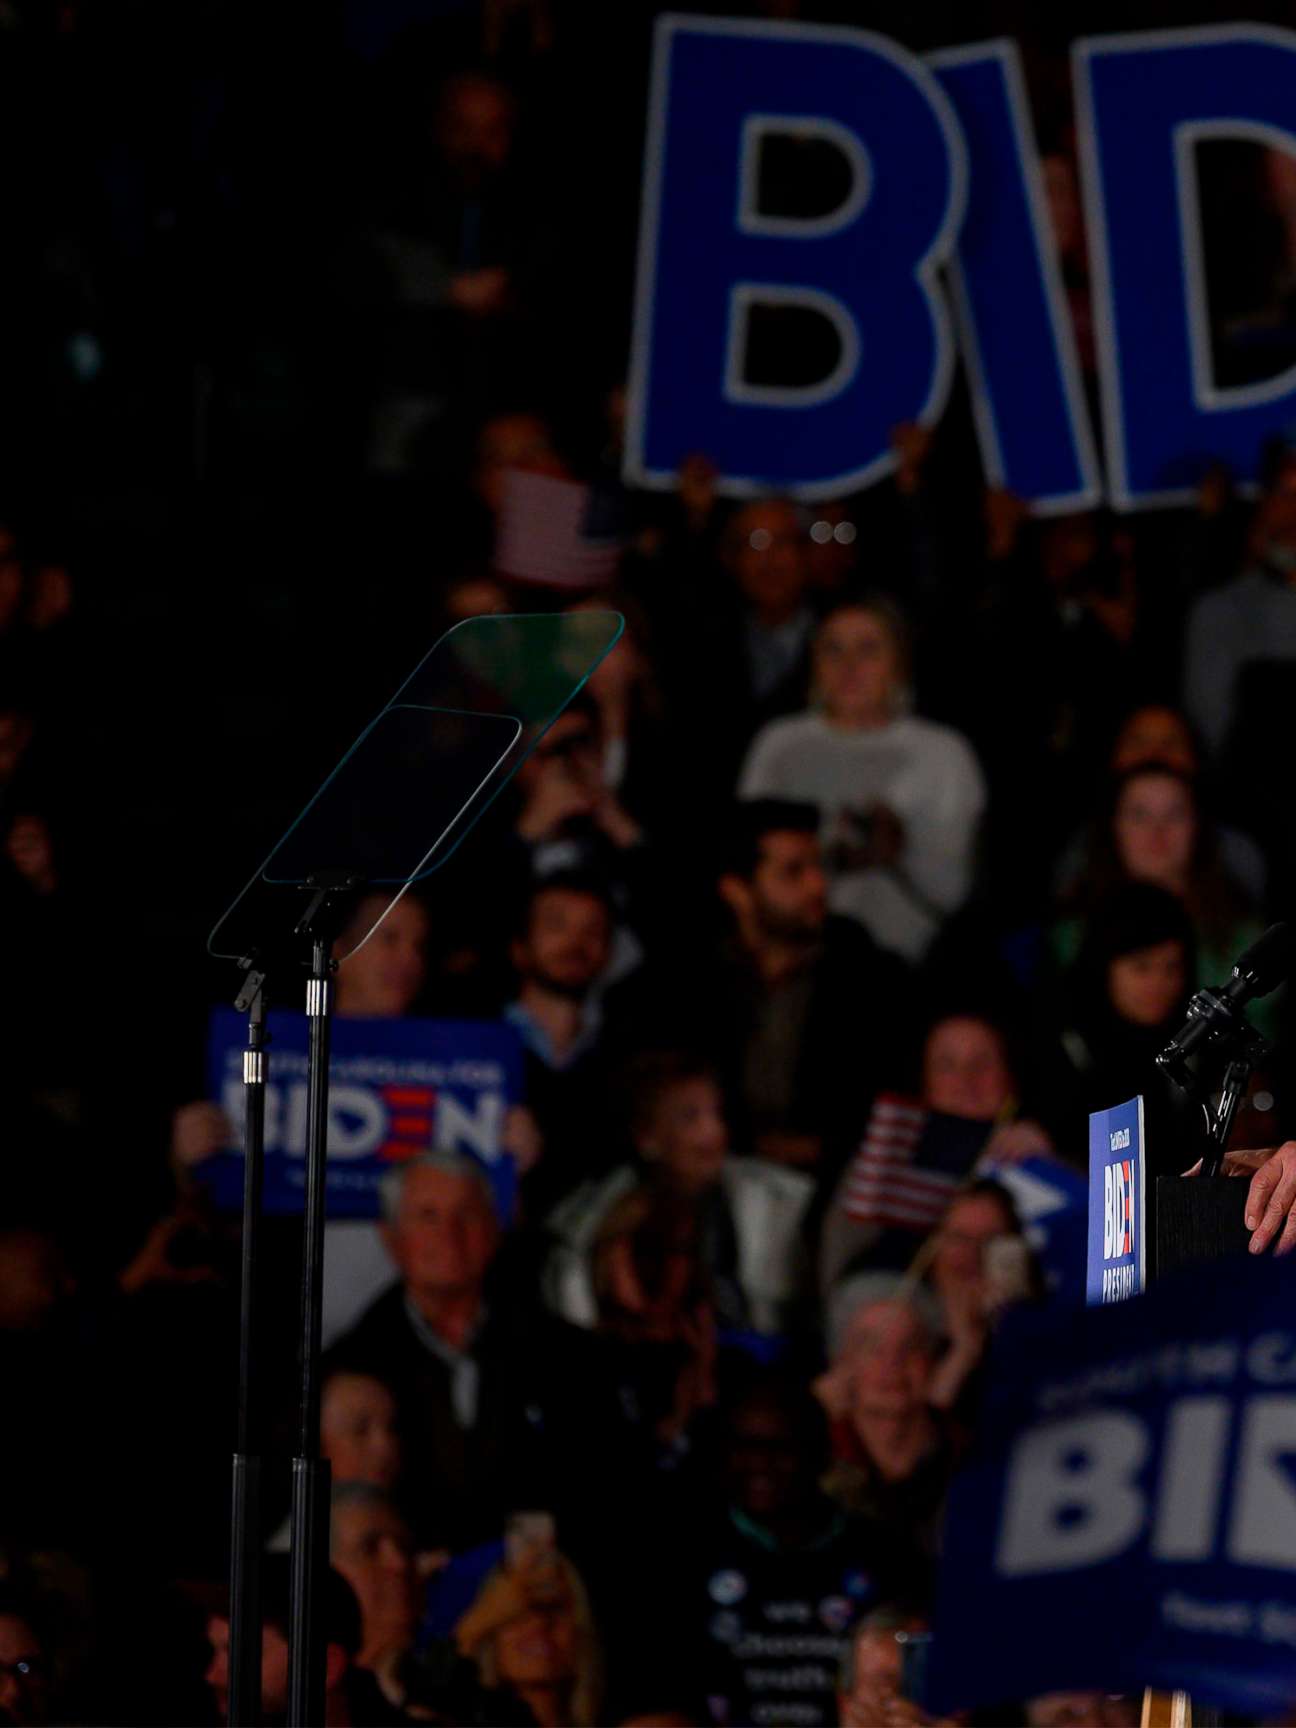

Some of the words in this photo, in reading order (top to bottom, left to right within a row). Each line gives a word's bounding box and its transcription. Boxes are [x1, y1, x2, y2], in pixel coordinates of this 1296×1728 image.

[220, 1078, 506, 1168] BIDEN
[1103, 1158, 1135, 1261] BIDEN
[1102, 1263, 1135, 1304] PRESIDENT
